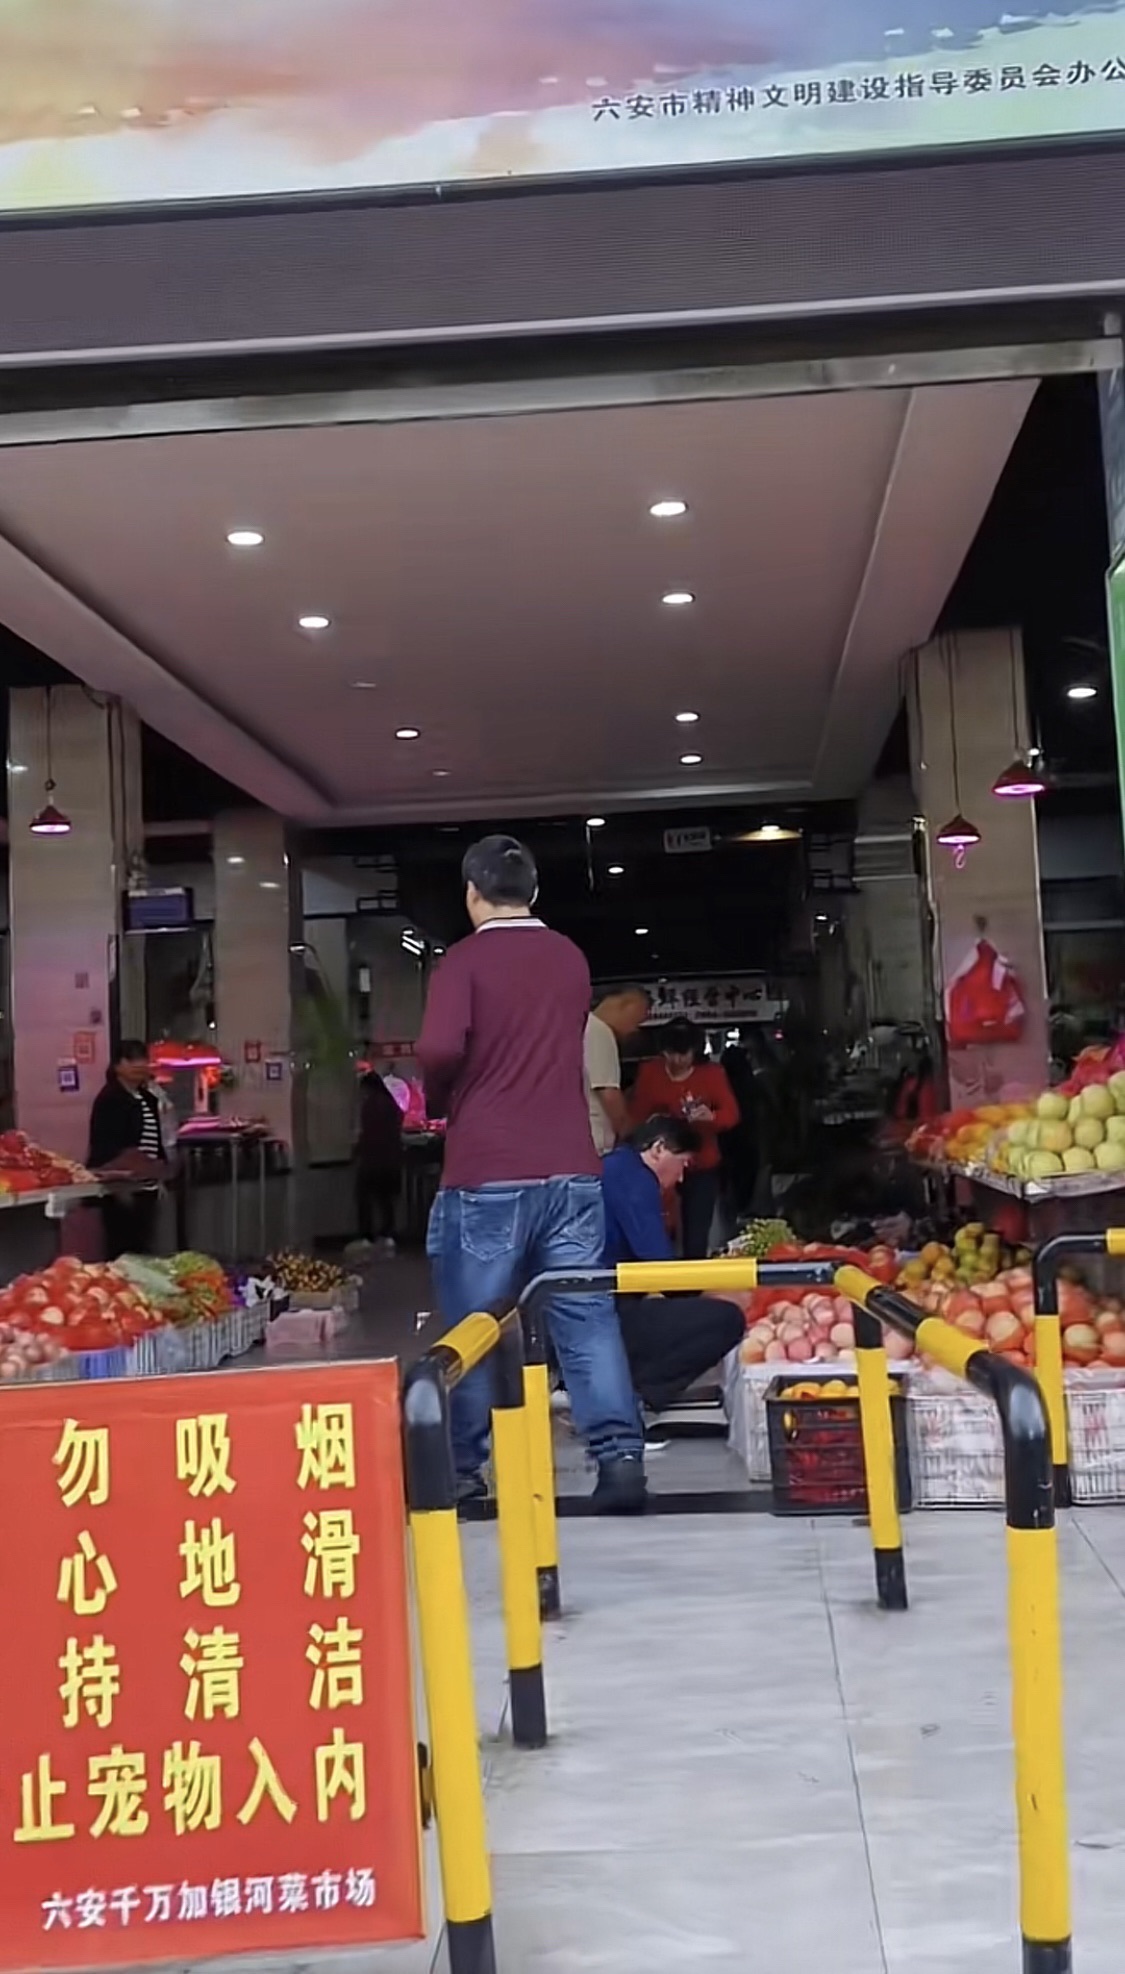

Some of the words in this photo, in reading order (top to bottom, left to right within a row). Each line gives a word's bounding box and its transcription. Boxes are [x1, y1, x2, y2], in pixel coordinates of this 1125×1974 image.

[593, 58, 1125, 121] 六安市精神文明建设指导委员会办公
[14, 1727, 366, 1842] 止宠物入内
[41, 1867, 375, 1931] 六安千万加银河菜市场
